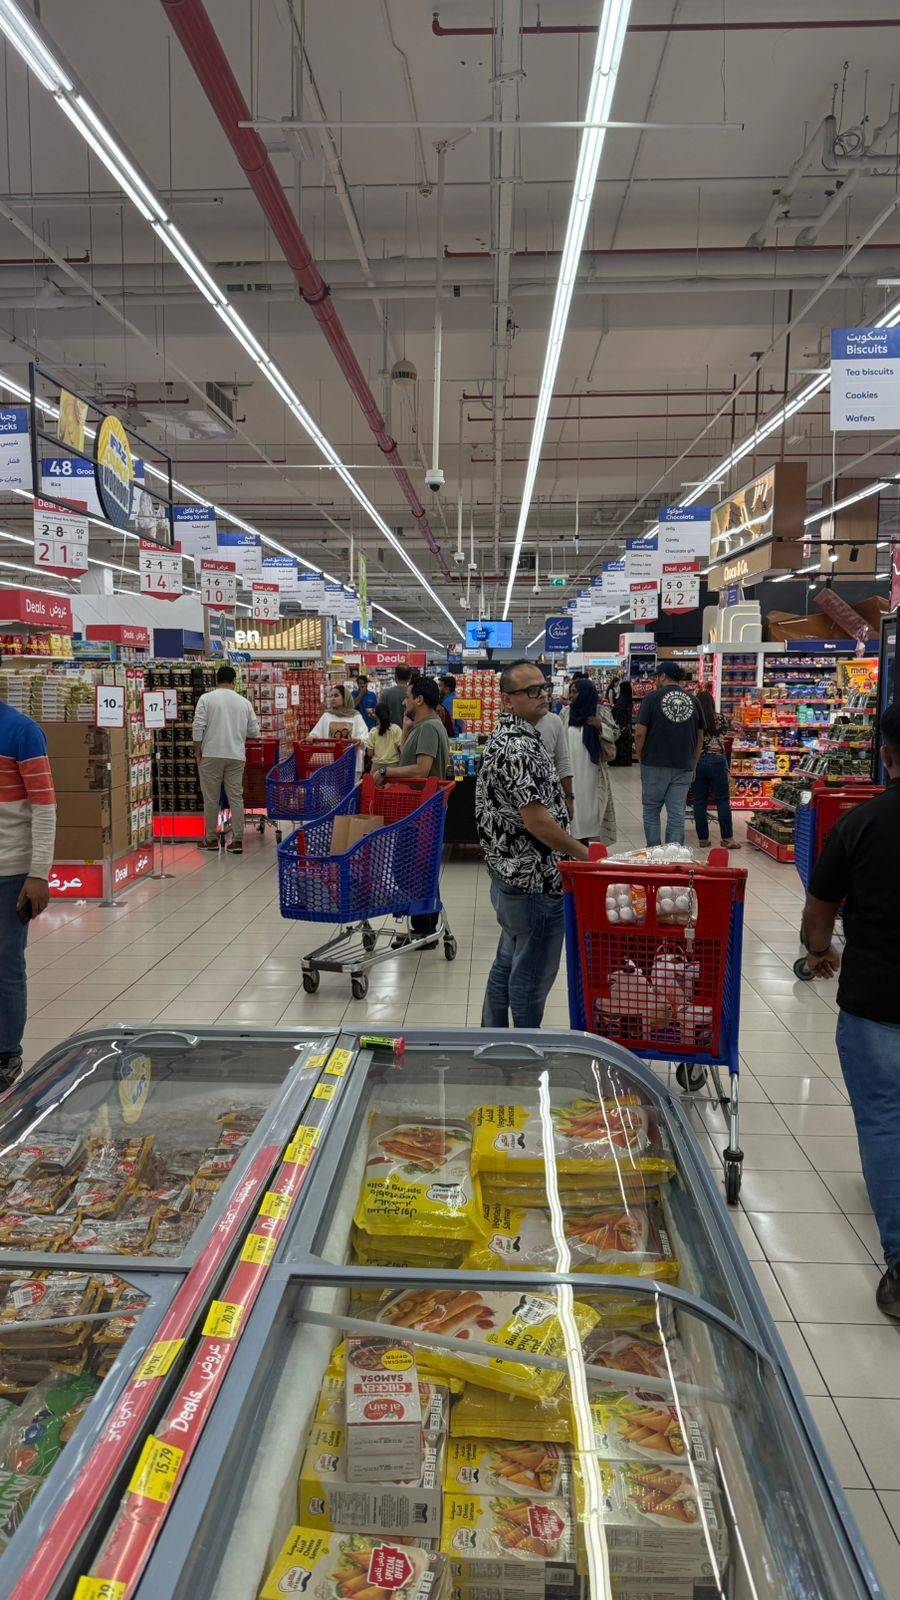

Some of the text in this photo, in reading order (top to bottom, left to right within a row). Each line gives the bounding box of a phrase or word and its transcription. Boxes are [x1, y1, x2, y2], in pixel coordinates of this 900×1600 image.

[847, 330, 887, 344] بسكويت
[846, 344, 888, 354] Biscuits
[863, 368, 894, 376] biscuits
[846, 391, 878, 399] Cookies
[846, 414, 875, 422] Wafers
[50, 460, 72, 475] 48
[145, 574, 167, 589] 14
[206, 590, 223, 603] 10
[664, 593, 685, 606] 42
[26, 599, 67, 619] Deals عروض
[633, 607, 647, 618] 12
[123, 630, 135, 639] Deals
[377, 653, 406, 663] Deals
[104, 698, 117, 709] 10
[148, 703, 159, 712] 17
[749, 800, 769, 808] عرض
[115, 864, 129, 883] Deal
[370, 1190, 417, 1200] Vegetable
[392, 1184, 422, 1195] Spring
[222, 1305, 236, 1327] 20.79
[200, 1344, 221, 1380] عروض
[360, 1374, 404, 1383] SAMOSA
[362, 1384, 406, 1394] CHICKEN
[170, 1390, 203, 1433] Deals
[369, 1402, 401, 1411] al ain
[154, 1448, 174, 1475] 15.79
[303, 1540, 315, 1557] Cheese
[384, 1556, 396, 1581] SPECIAL
[394, 1558, 405, 1580] OFFER
